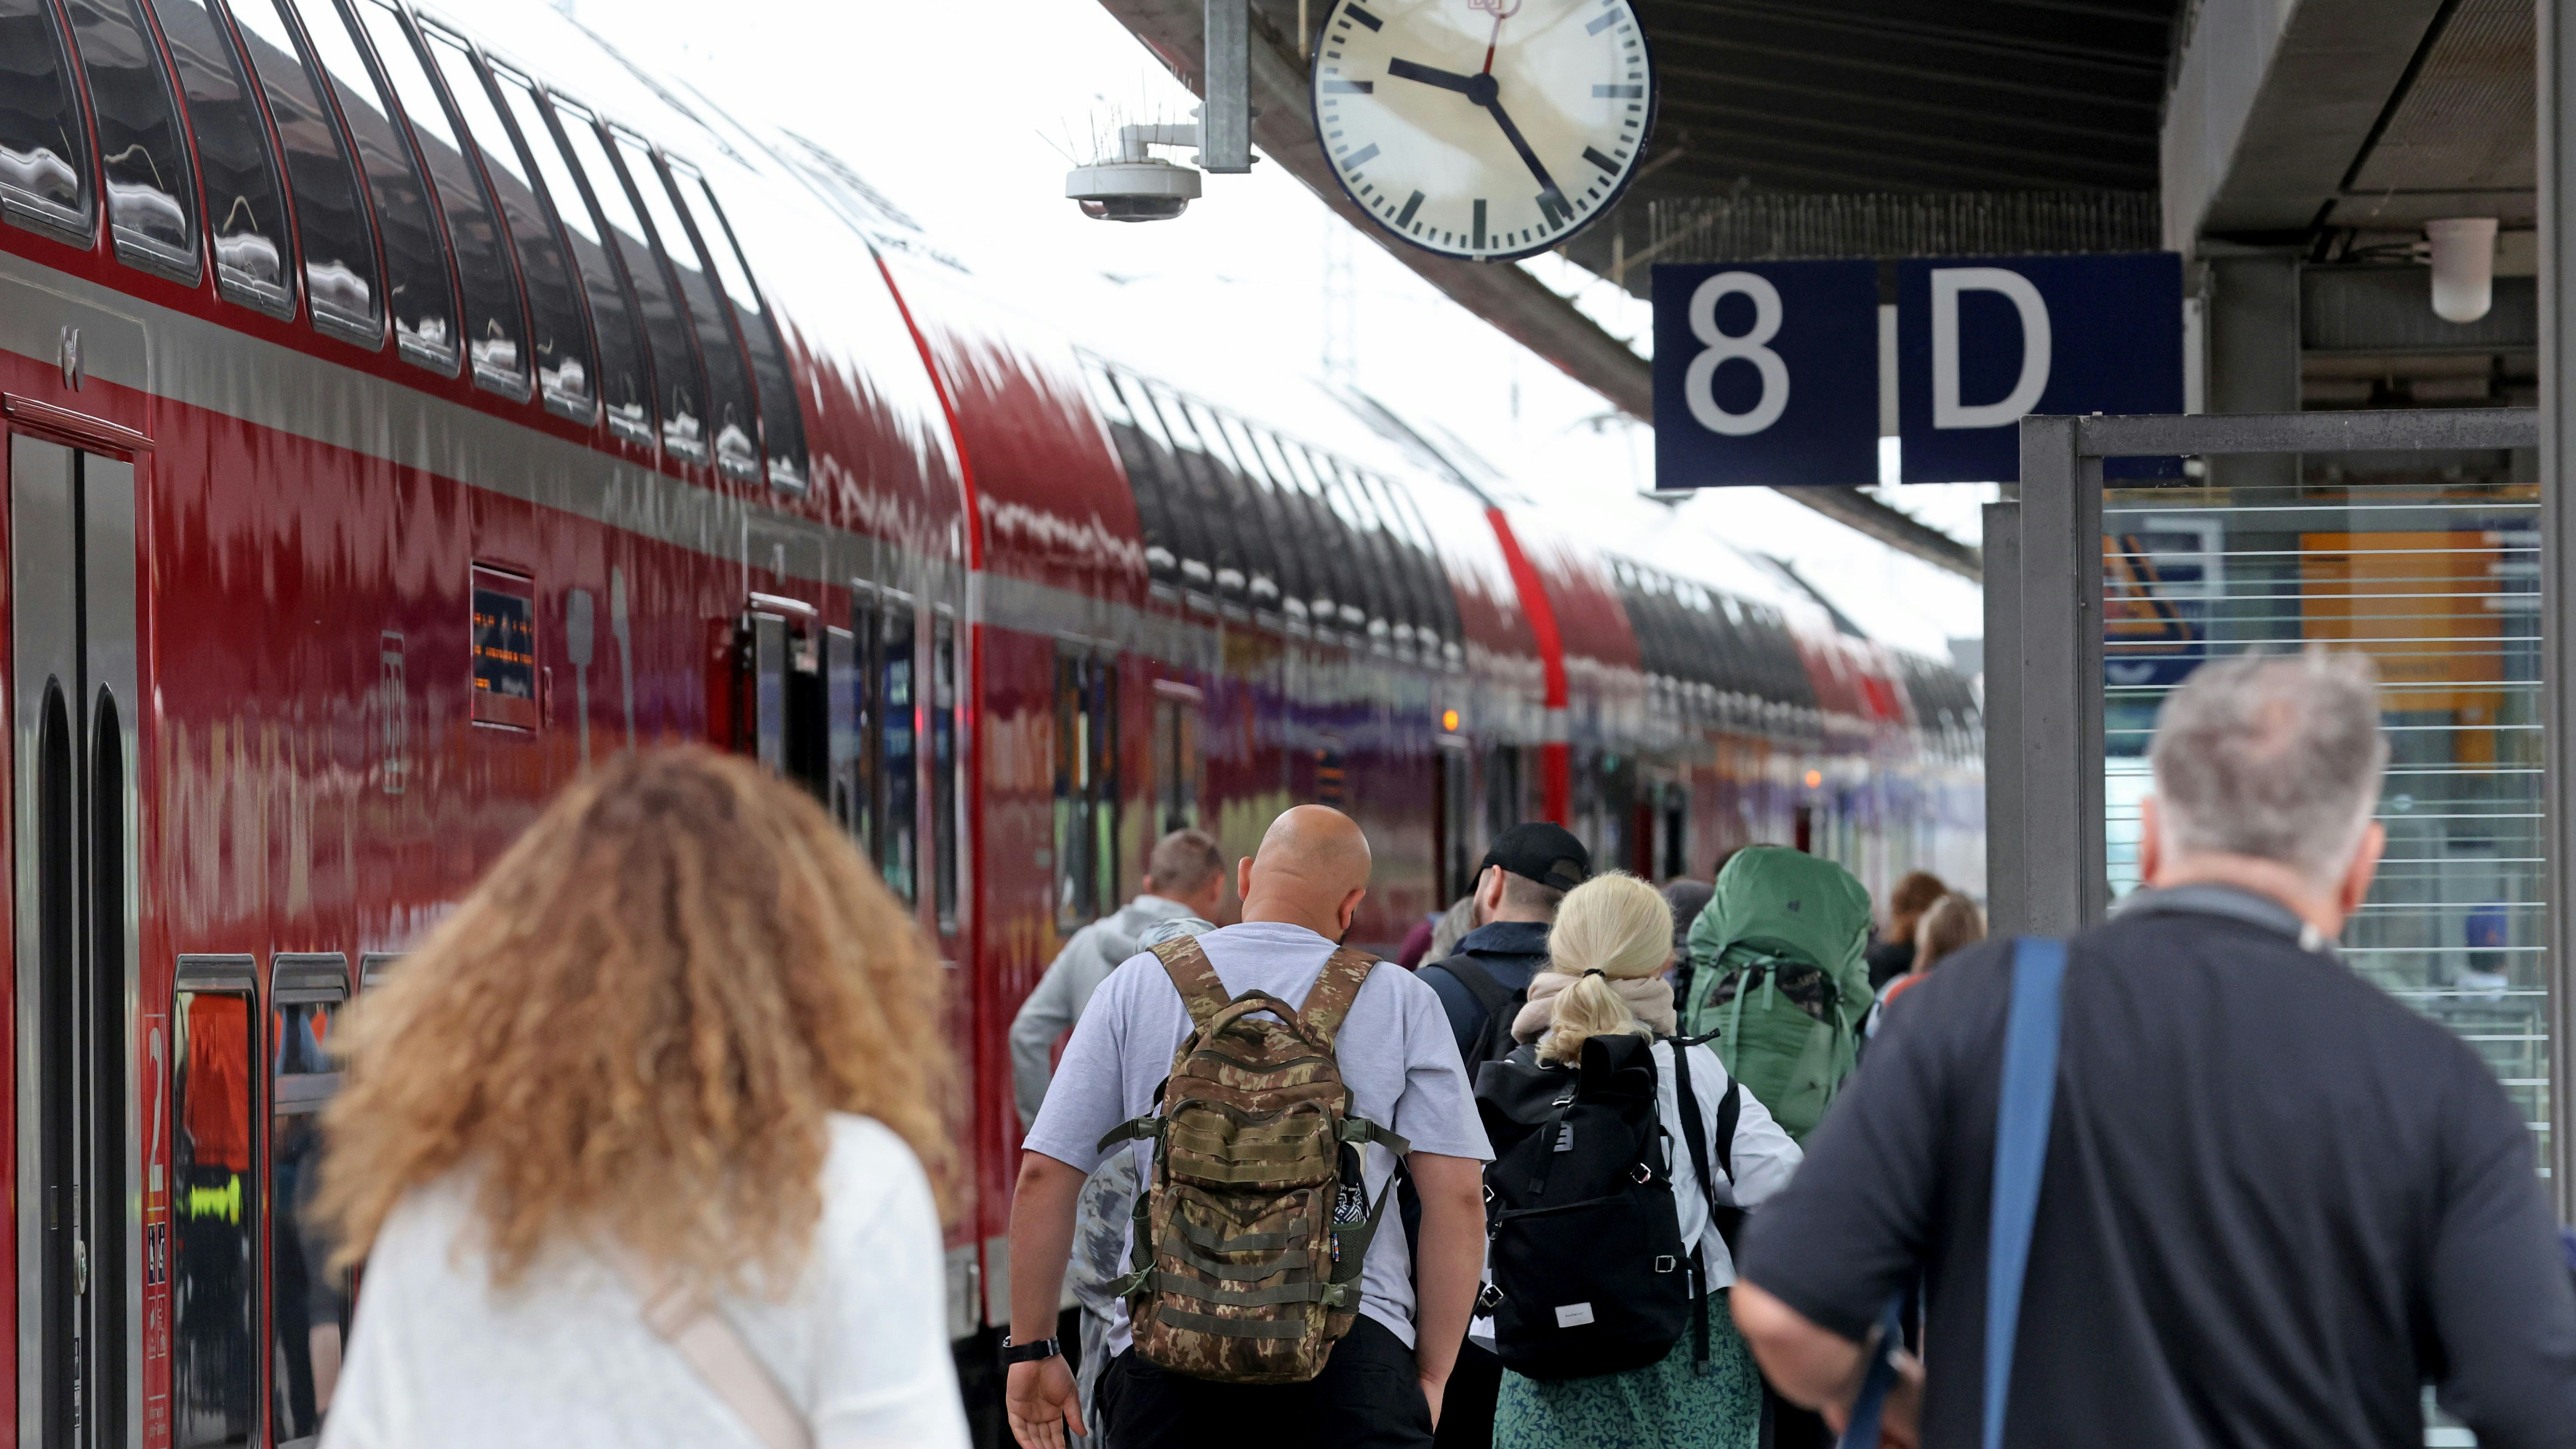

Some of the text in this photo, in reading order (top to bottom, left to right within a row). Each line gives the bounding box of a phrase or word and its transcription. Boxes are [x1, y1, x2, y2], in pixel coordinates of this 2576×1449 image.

[1684, 271, 1790, 436] 8
[1930, 266, 2052, 429] D
[149, 1027, 164, 1192] 2
